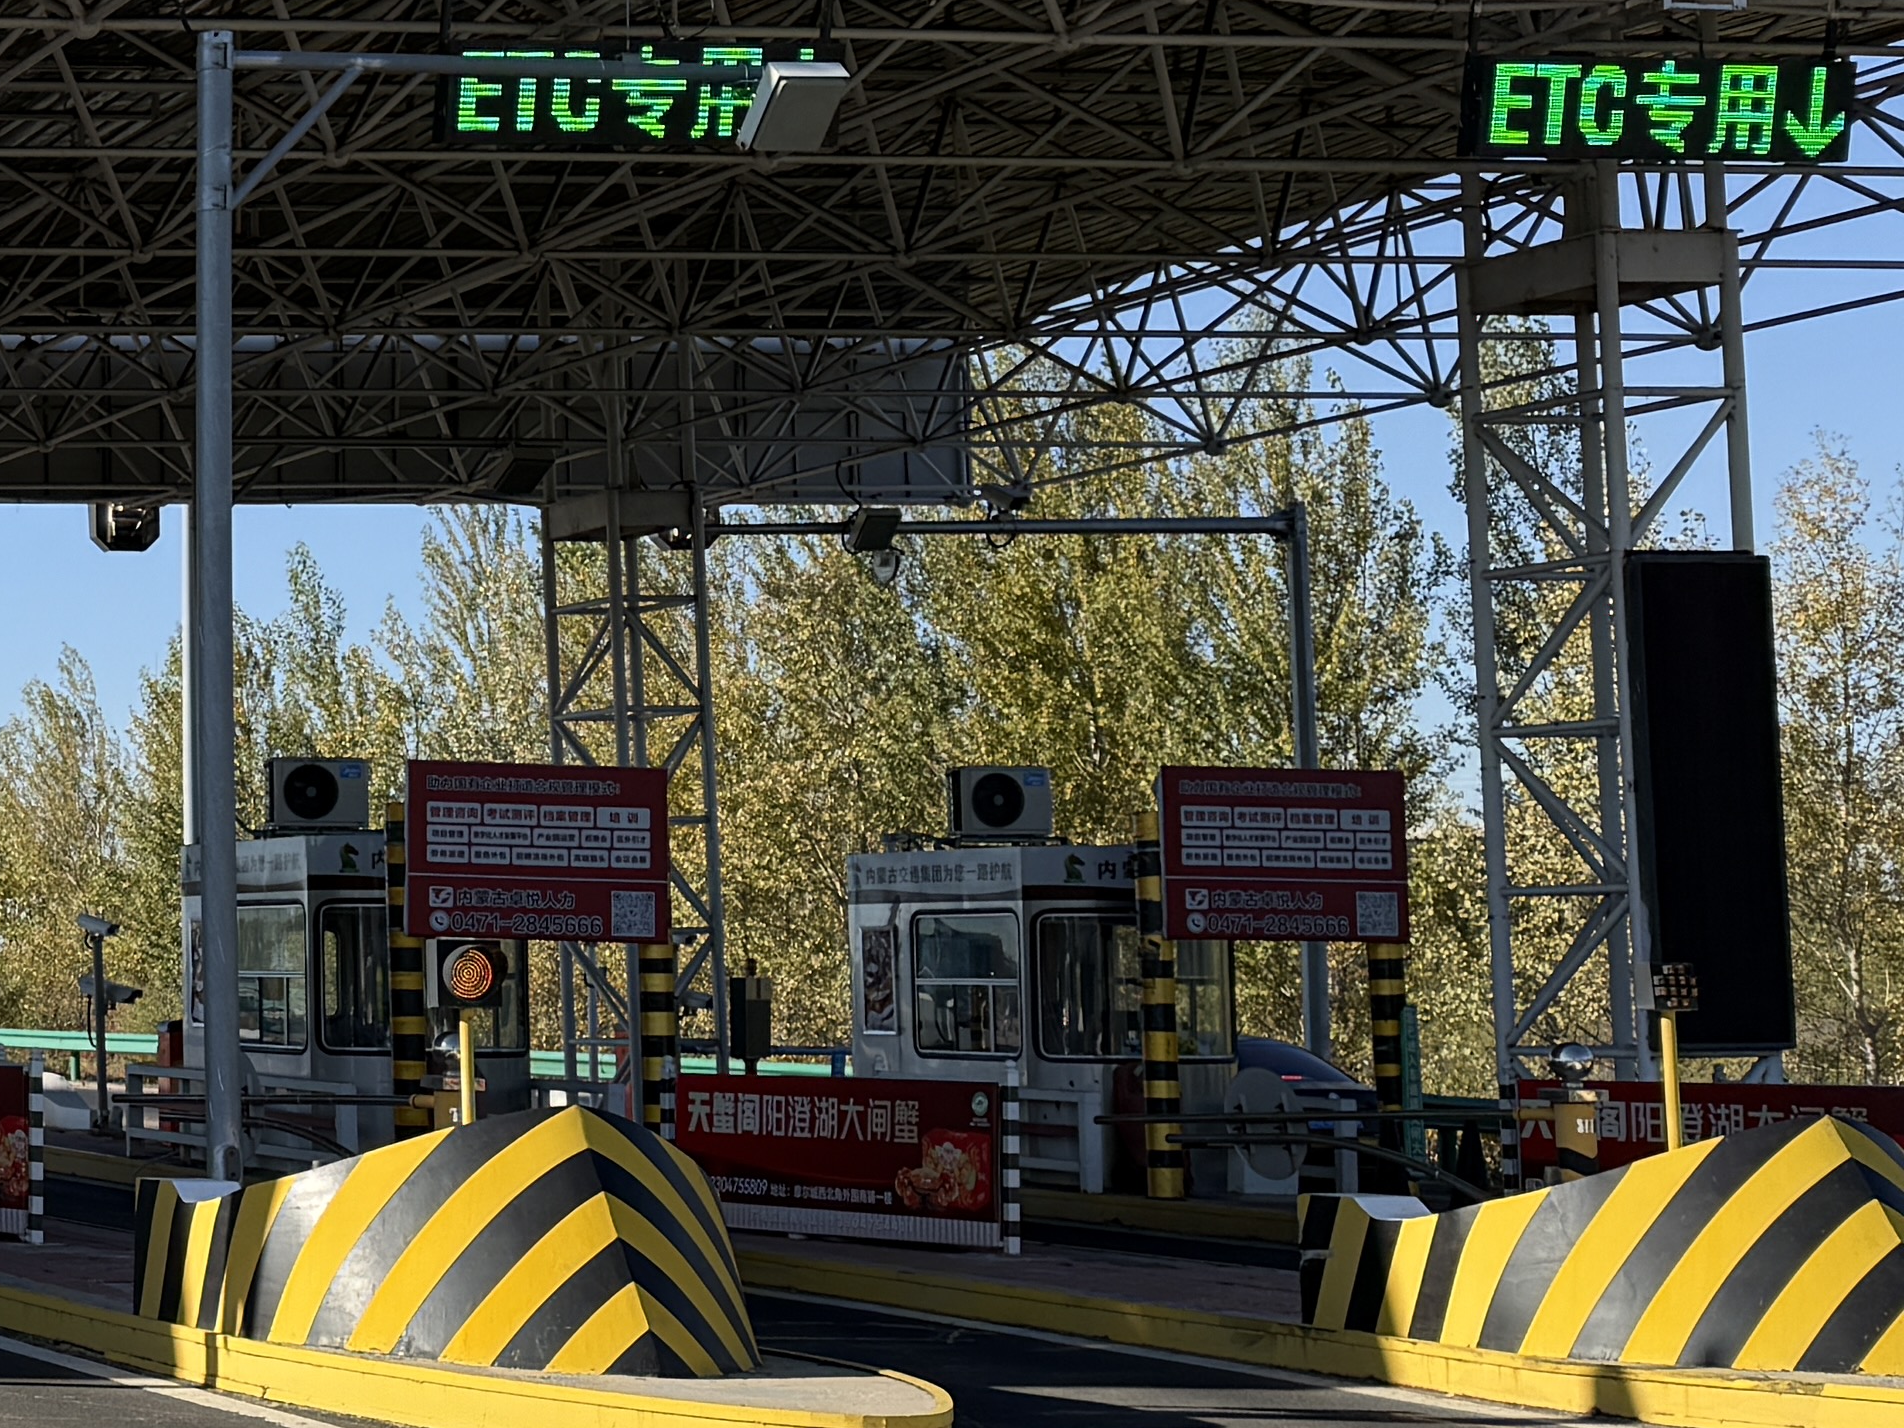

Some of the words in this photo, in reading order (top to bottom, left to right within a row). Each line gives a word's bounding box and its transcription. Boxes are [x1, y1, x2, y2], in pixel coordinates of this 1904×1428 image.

[1489, 59, 1780, 154] ETC专用
[450, 912, 603, 935] 0471-2845666
[1207, 913, 1349, 936] 0471-2845666
[688, 1091, 920, 1144] 天蟹阁阳澄湖大闸蟹
